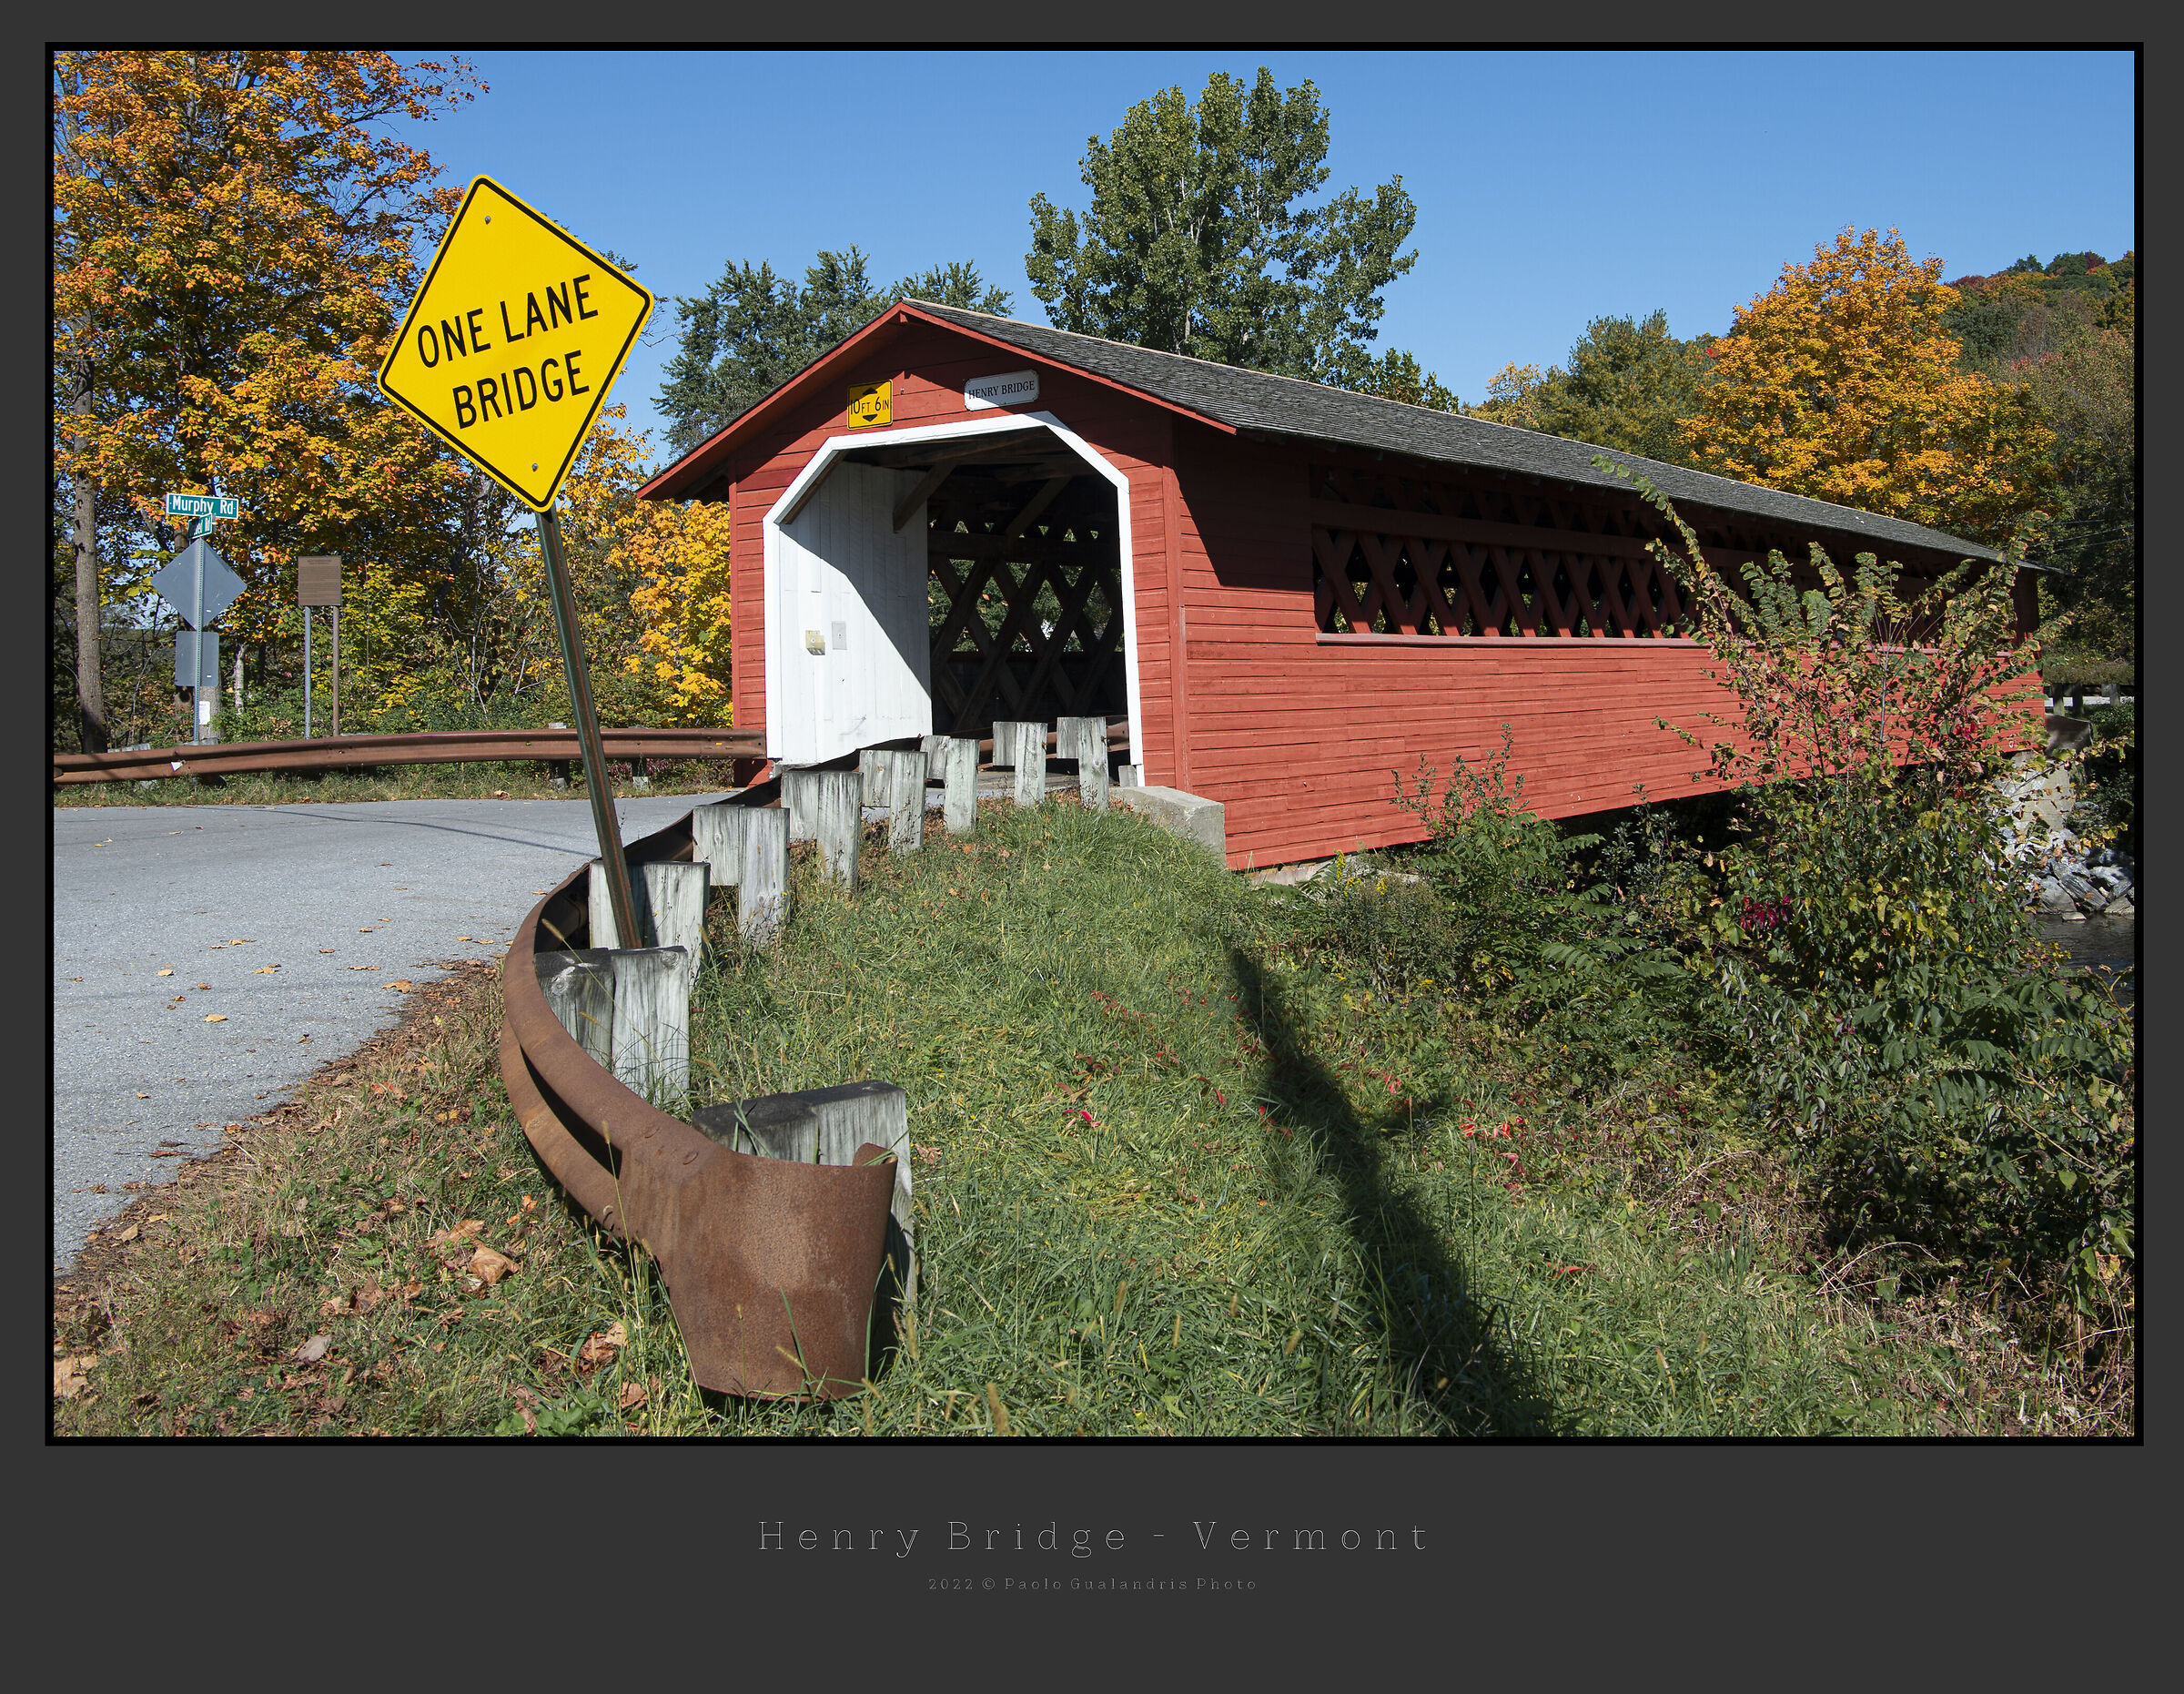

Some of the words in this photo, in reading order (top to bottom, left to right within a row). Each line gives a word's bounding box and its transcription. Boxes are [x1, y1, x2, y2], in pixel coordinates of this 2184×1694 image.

[418, 308, 491, 369] ONE
[500, 274, 599, 343] LANE
[452, 350, 590, 430] BRIDGE
[968, 385, 999, 400] HENRY
[1002, 380, 1035, 395] BRIDGE
[172, 495, 214, 515] Murphy
[219, 499, 234, 514] Rd
